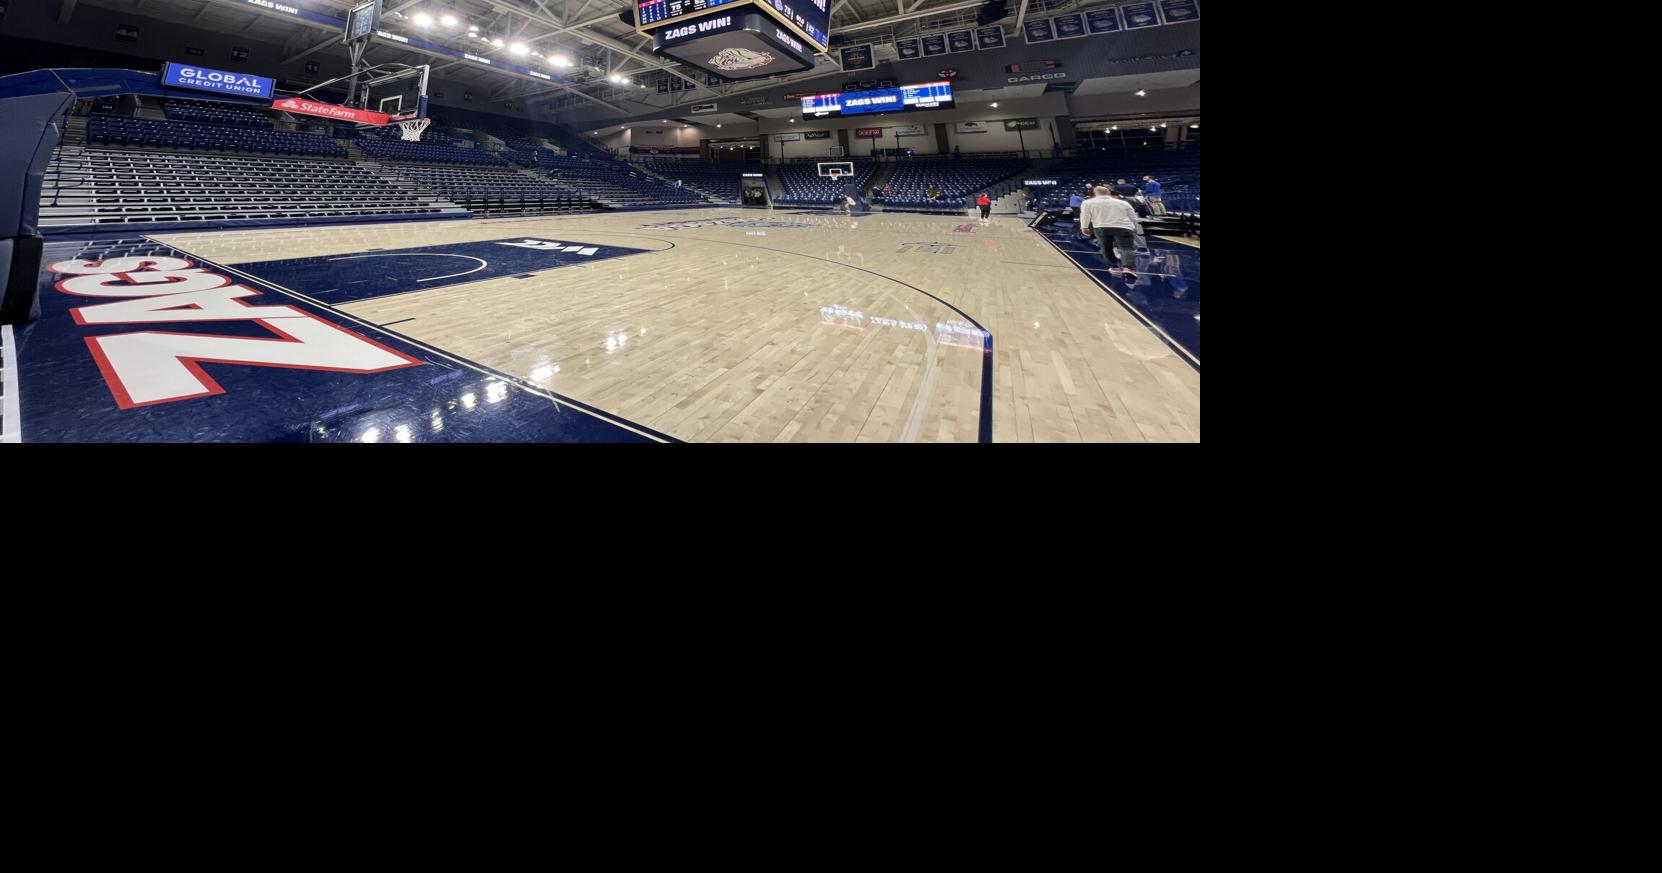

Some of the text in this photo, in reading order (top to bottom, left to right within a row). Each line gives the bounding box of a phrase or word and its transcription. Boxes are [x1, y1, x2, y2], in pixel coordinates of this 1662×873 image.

[275, 4, 298, 14] WIN!
[665, 16, 731, 40] ZAGS WIN!
[178, 77, 261, 94] CREDIT UNION
[180, 68, 262, 88] GLOBAL
[845, 98, 871, 107] ZAGS
[871, 96, 897, 105] WIN!
[47, 255, 424, 409] ZAGS
